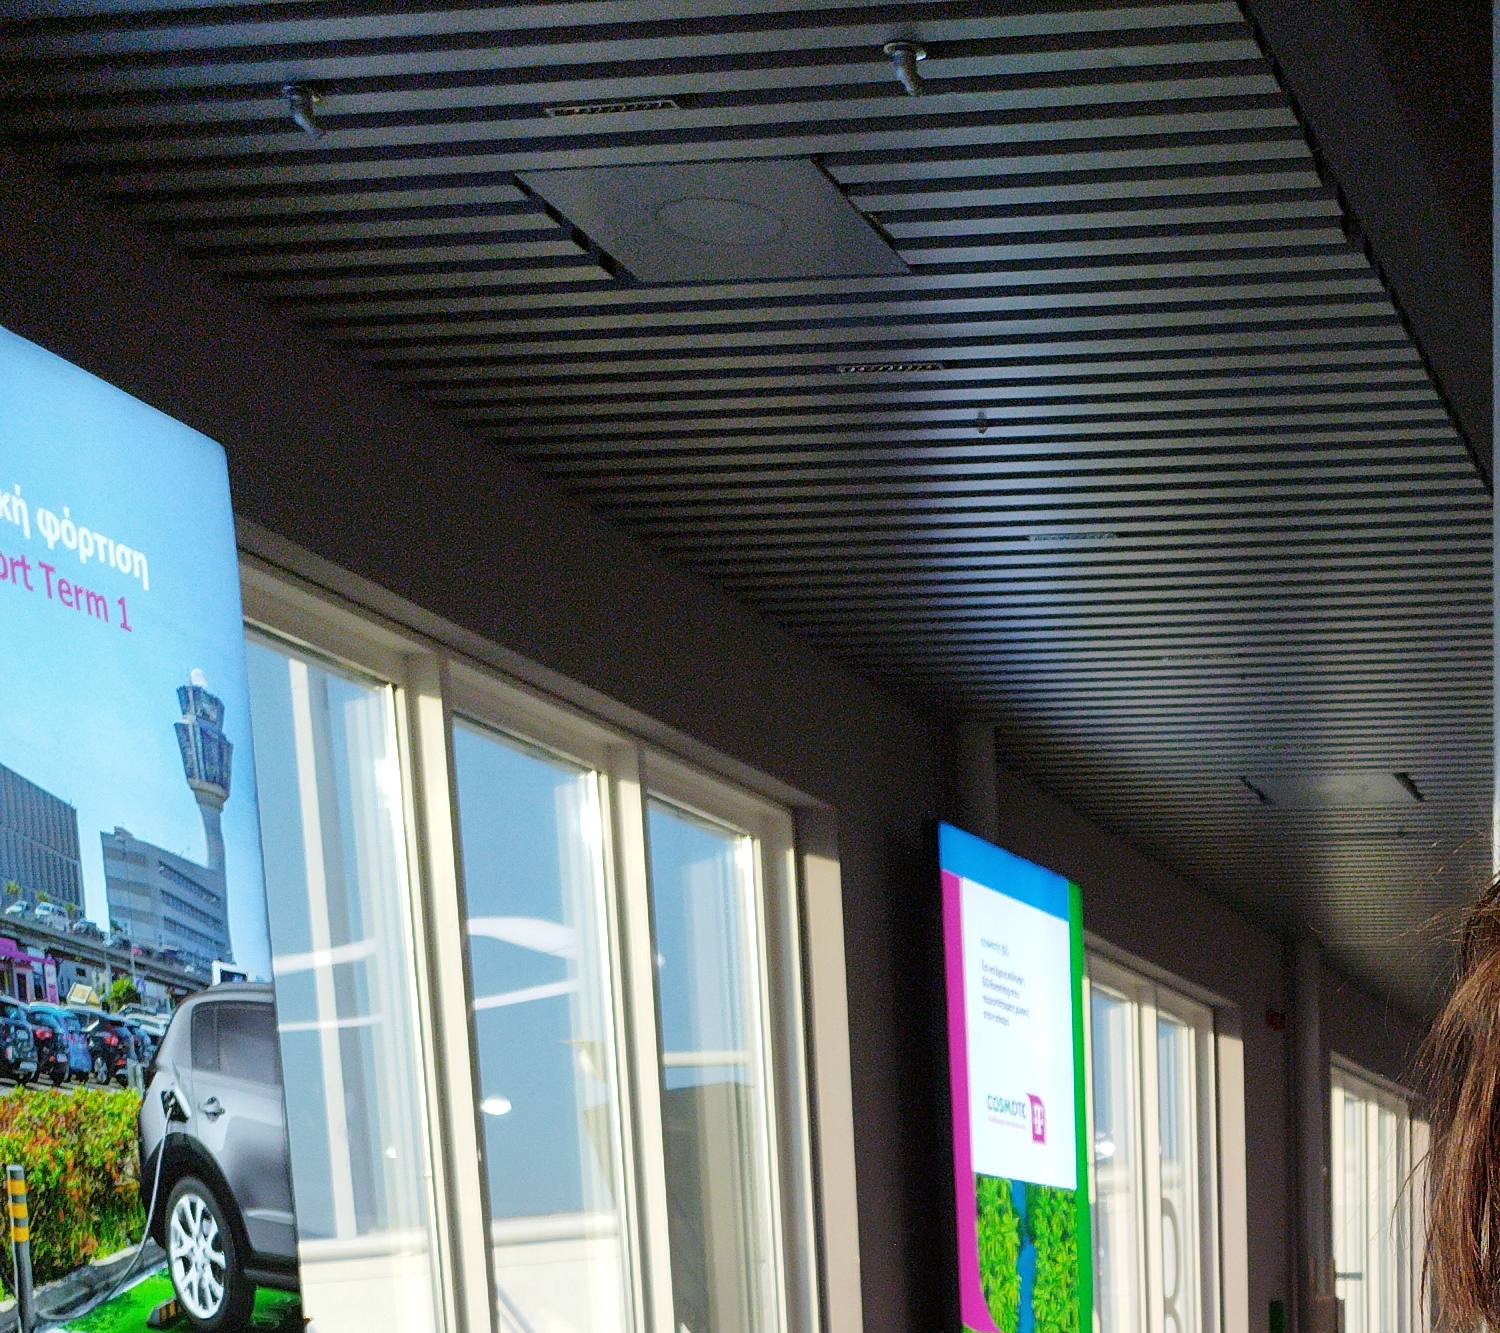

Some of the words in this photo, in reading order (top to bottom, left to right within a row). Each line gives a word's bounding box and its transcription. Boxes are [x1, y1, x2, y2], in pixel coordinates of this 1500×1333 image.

[36, 506, 149, 591] φόρτιση
[38, 561, 109, 623] Term
[117, 597, 132, 632] 1
